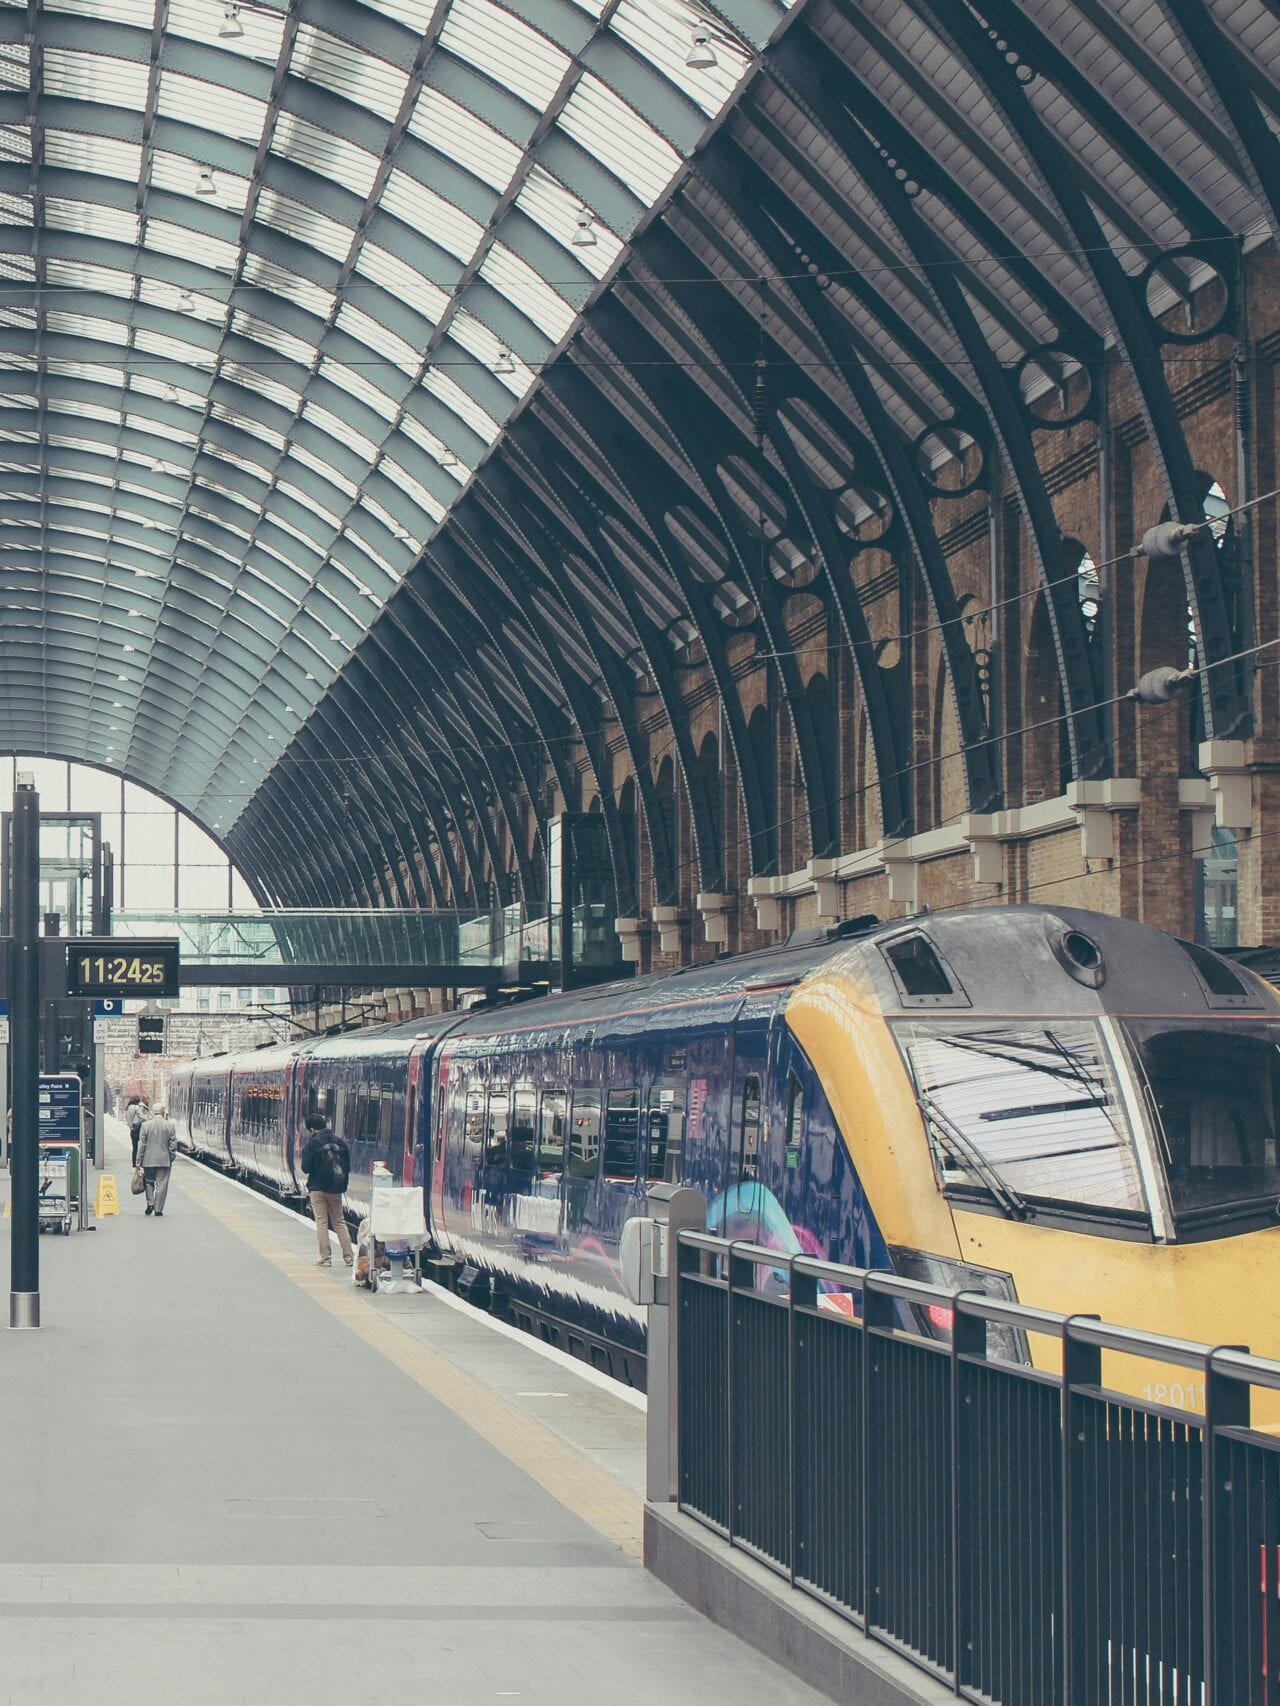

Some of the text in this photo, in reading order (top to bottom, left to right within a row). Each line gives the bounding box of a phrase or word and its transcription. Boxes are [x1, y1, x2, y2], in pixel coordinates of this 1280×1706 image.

[80, 957, 164, 983] 11:24 25
[103, 999, 114, 1011] 6
